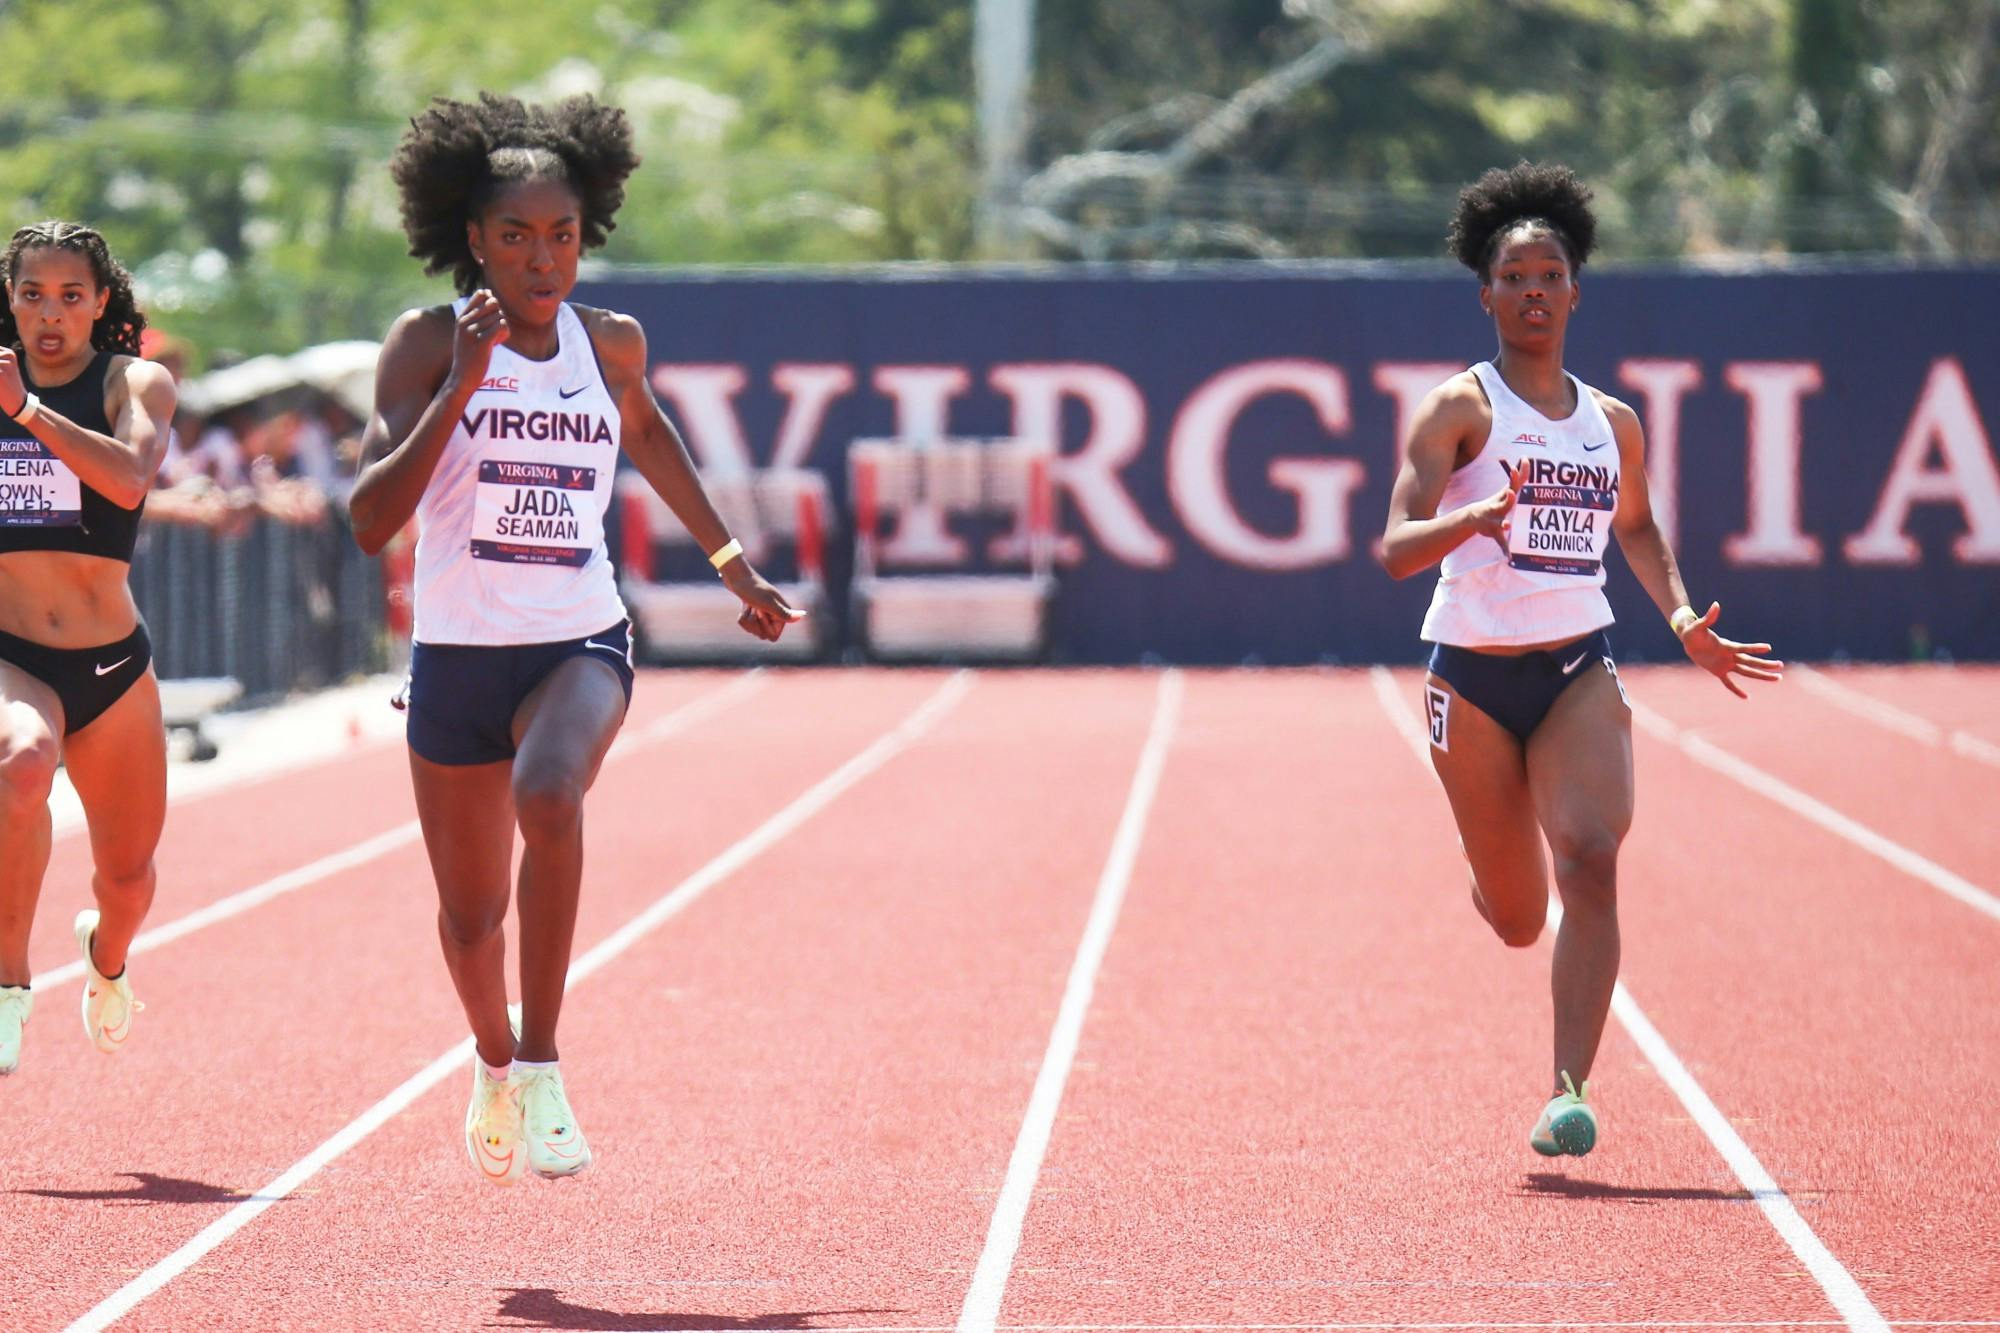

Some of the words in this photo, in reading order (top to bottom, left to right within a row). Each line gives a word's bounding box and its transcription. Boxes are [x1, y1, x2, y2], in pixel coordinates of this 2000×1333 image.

[480, 376, 519, 390] ACC
[460, 408, 613, 446] VIRGINIA
[0, 441, 42, 452] RGINIA
[1514, 433, 1547, 444] ACC
[497, 463, 559, 480] VIRGINIA
[652, 359, 2000, 567] VIRGIA
[504, 488, 575, 517] JADA
[1533, 487, 1583, 502] VIRGINIA
[496, 517, 579, 540] SEAMAN
[1529, 508, 1594, 534] KAYLA
[1528, 532, 1594, 553] BONNICK
[1430, 692, 1444, 743] 5
